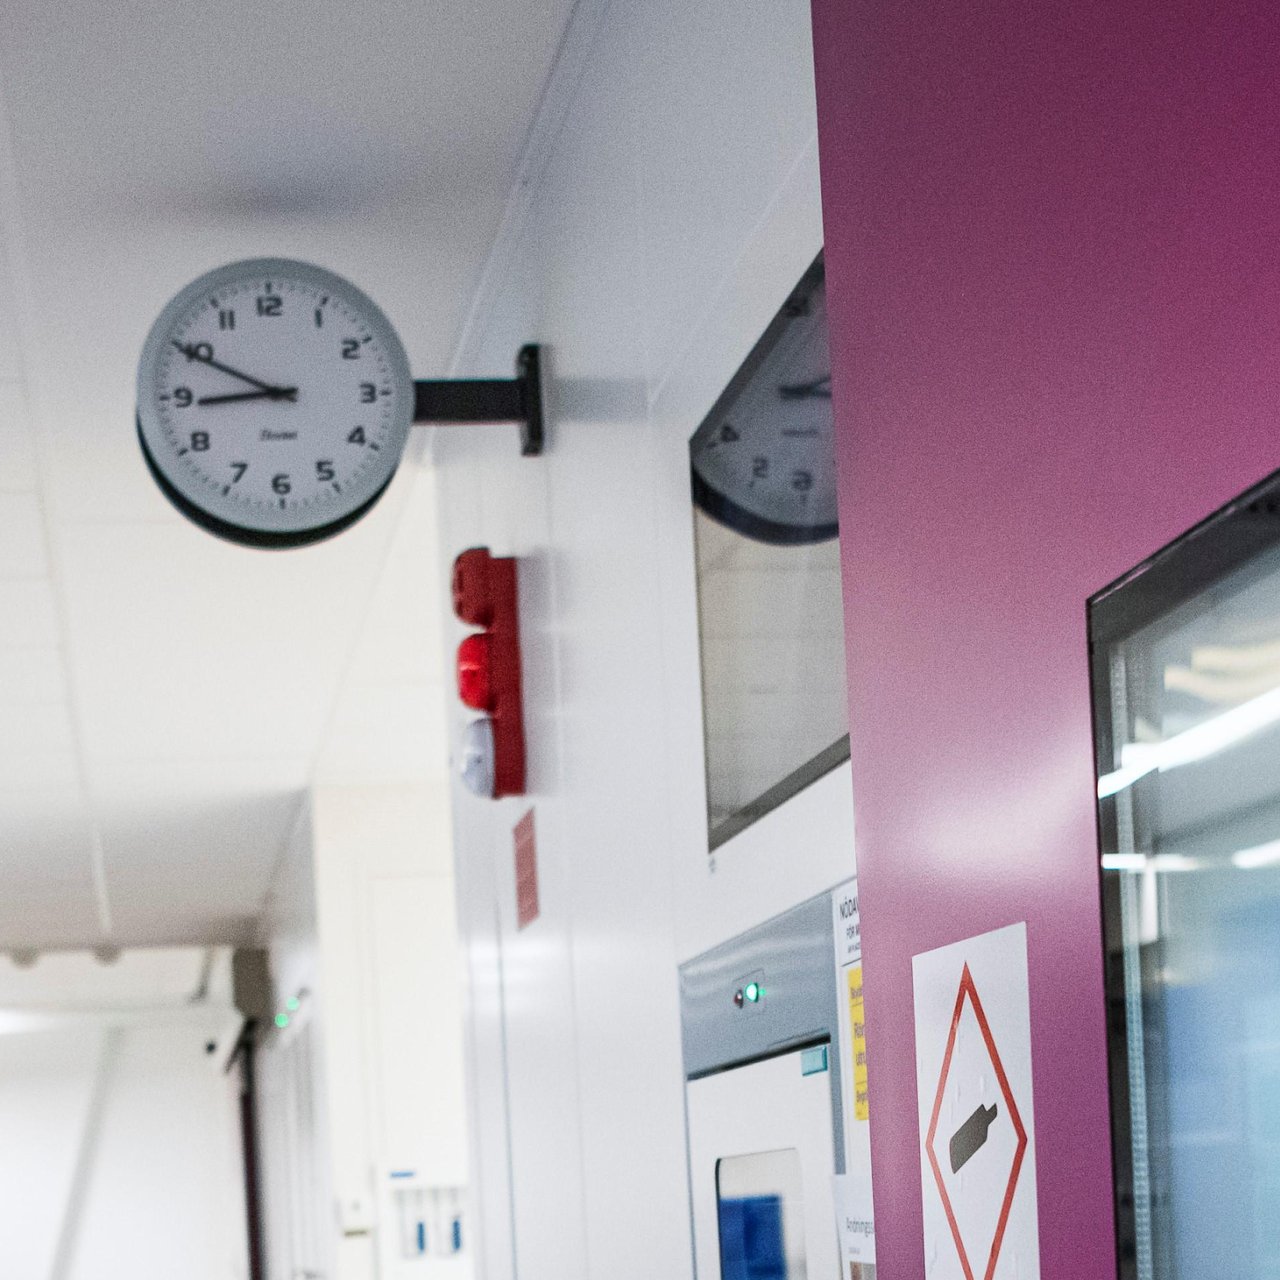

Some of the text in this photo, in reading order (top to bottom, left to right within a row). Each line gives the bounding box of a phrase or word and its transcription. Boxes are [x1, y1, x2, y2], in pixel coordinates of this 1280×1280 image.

[256, 297, 282, 317] 12
[220, 310, 235, 330] 11
[315, 309, 322, 328] 1
[342, 339, 360, 359] 2
[174, 387, 193, 408] 9
[360, 384, 377, 403] 3
[191, 431, 210, 451] 8
[347, 426, 366, 445] 4
[230, 462, 248, 483] 7
[316, 460, 334, 481] 5
[272, 474, 291, 494] 6
